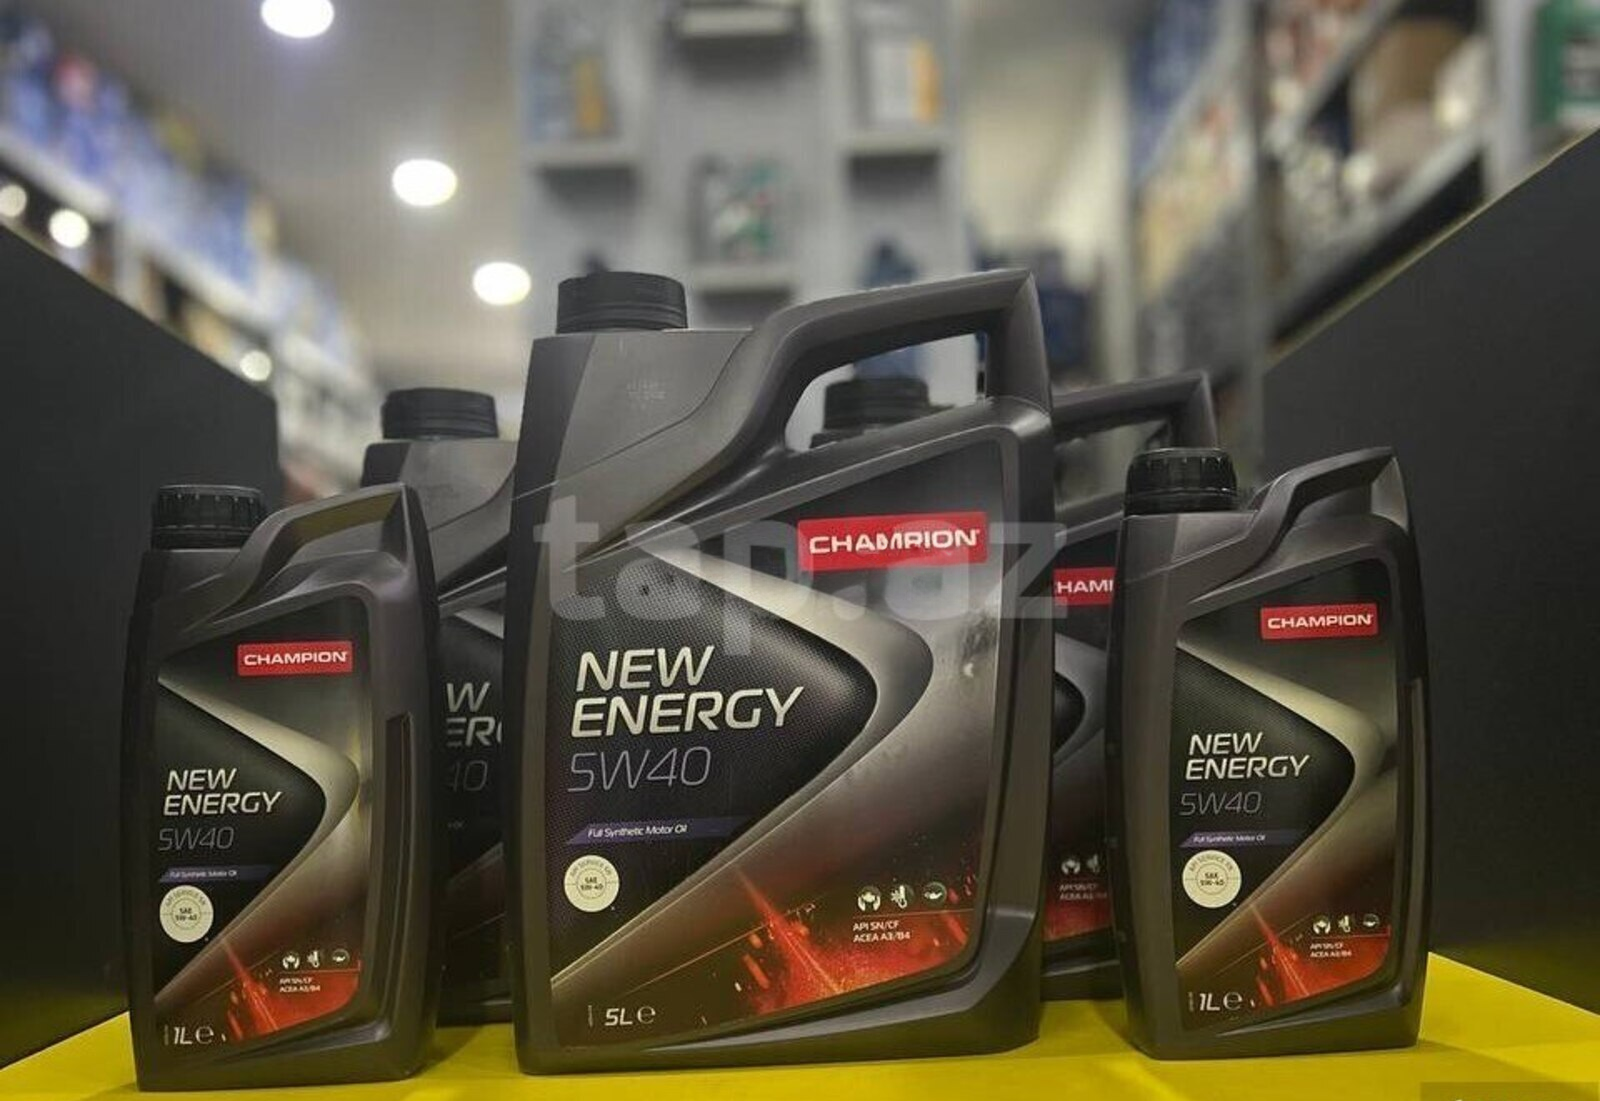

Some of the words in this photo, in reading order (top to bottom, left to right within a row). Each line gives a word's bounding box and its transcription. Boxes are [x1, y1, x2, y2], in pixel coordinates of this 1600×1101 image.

[809, 529, 980, 554] CHAMPION
[1267, 614, 1373, 629] CHAMPION
[244, 651, 347, 666] CHAMPION
[576, 645, 715, 692] NEW
[571, 686, 804, 738] ENERGY
[1189, 732, 1263, 756] NEW
[167, 768, 237, 791] NEW
[567, 746, 712, 793] 5W40
[1186, 755, 1310, 781] ENERGY
[163, 791, 282, 816] ENERGY
[1179, 791, 1262, 816] 5W40
[159, 826, 235, 851] 5W40
[588, 828, 603, 838] Full
[604, 826, 644, 839] Synthetic
[645, 825, 674, 836] Motor
[674, 823, 688, 833] Oil
[852, 922, 869, 932] API
[870, 920, 900, 931] SN/CF
[852, 933, 879, 943] ACEA
[880, 931, 911, 941] A3/B4
[1199, 992, 1221, 1011] 1L
[604, 1007, 633, 1026] 5L
[173, 1026, 193, 1045] 1L
